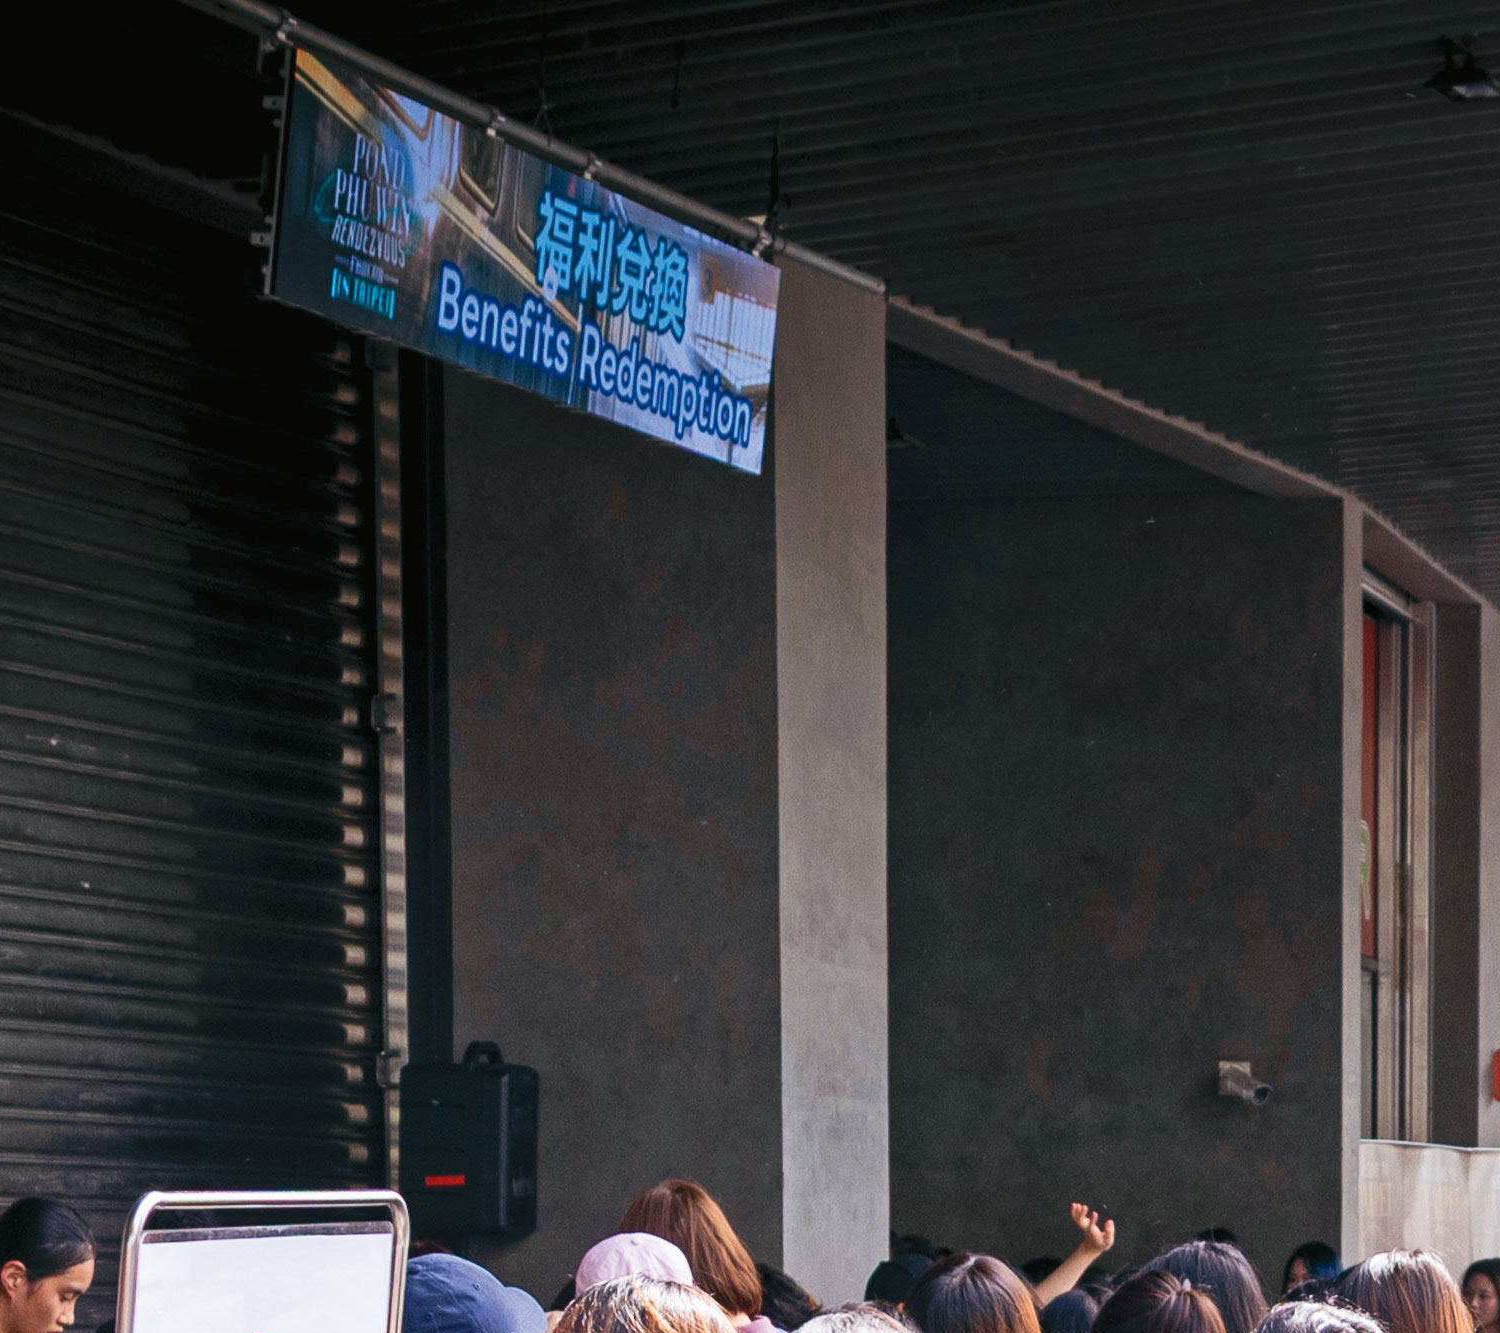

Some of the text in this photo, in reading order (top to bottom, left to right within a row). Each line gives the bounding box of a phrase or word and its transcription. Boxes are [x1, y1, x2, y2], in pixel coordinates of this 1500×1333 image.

[352, 132, 406, 190] POND
[333, 167, 413, 238] PHUWIN
[331, 213, 407, 269] RENDEZVOUS
[535, 190, 689, 344] 福利兌換
[438, 266, 753, 447] Benefits Redemption
